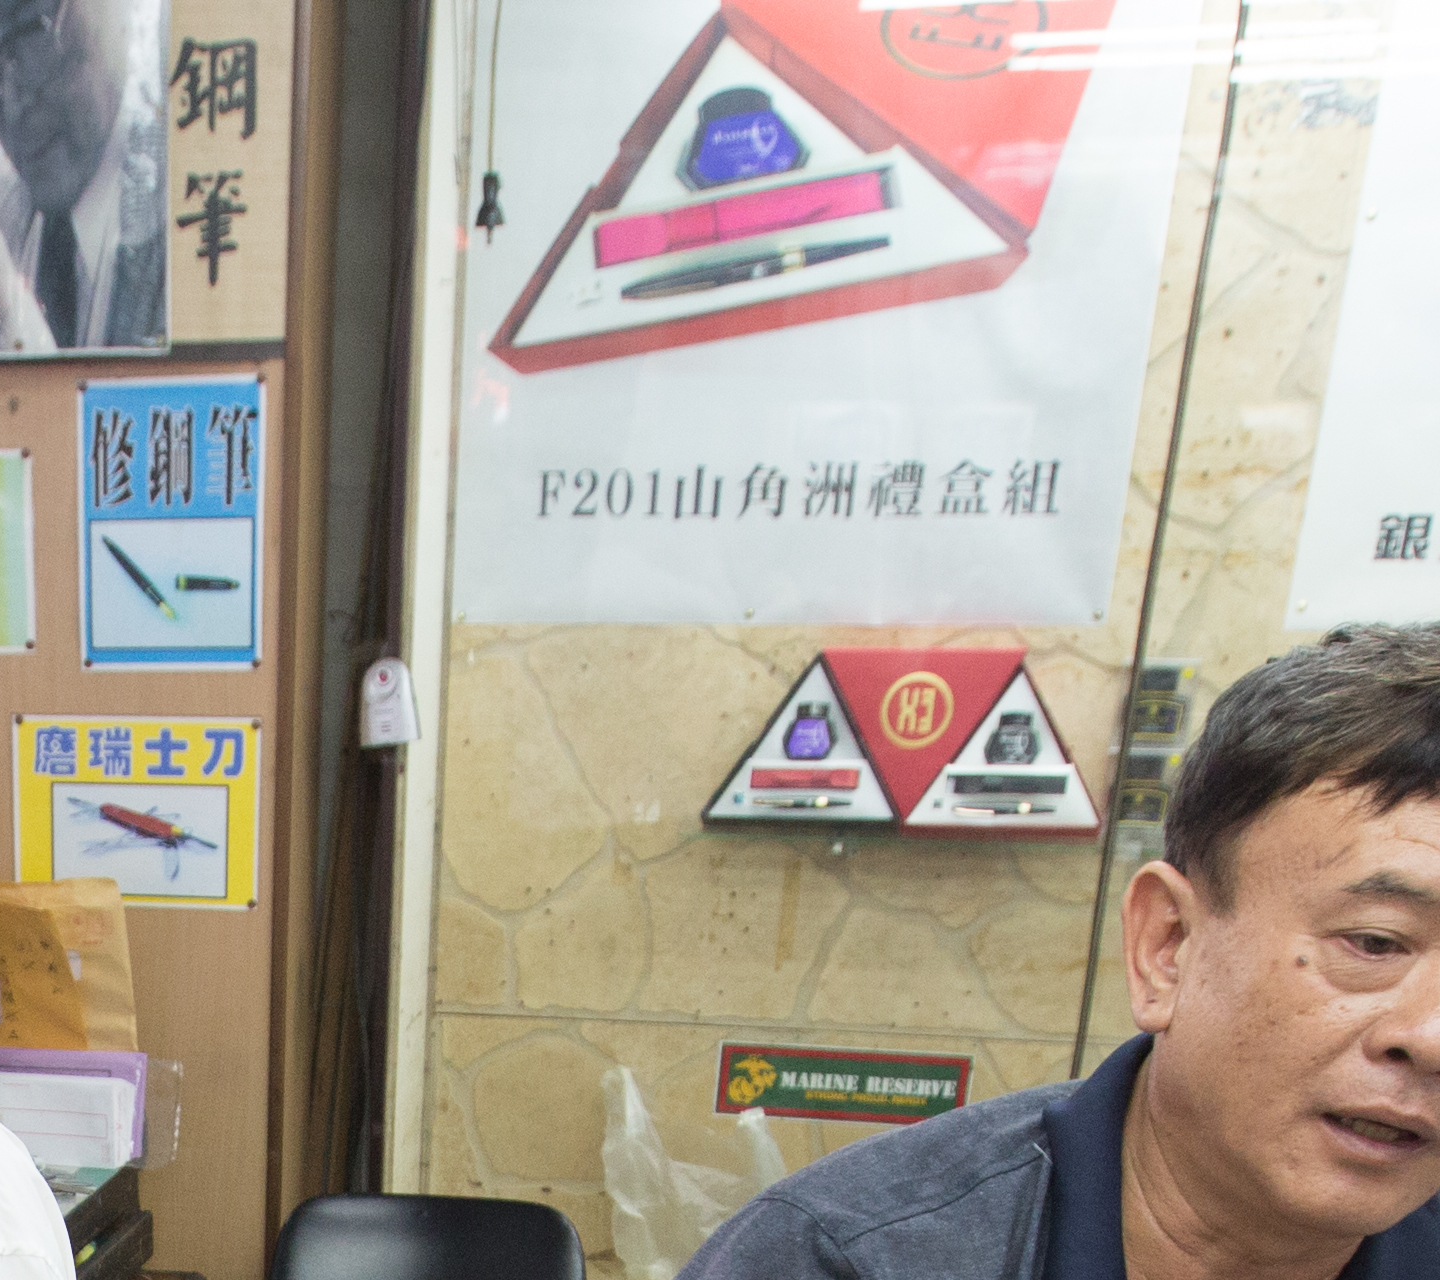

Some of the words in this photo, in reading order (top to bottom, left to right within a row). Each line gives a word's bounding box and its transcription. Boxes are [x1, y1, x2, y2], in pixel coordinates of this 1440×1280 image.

[167, 36, 260, 288] 鋼筆
[90, 405, 259, 508] 修鋼筆
[536, 458, 1065, 522] F201山角洲禮盒組
[33, 727, 246, 778] 磨瑞士刀
[779, 1071, 859, 1092] MARINE
[866, 1076, 957, 1098] RESERVE
